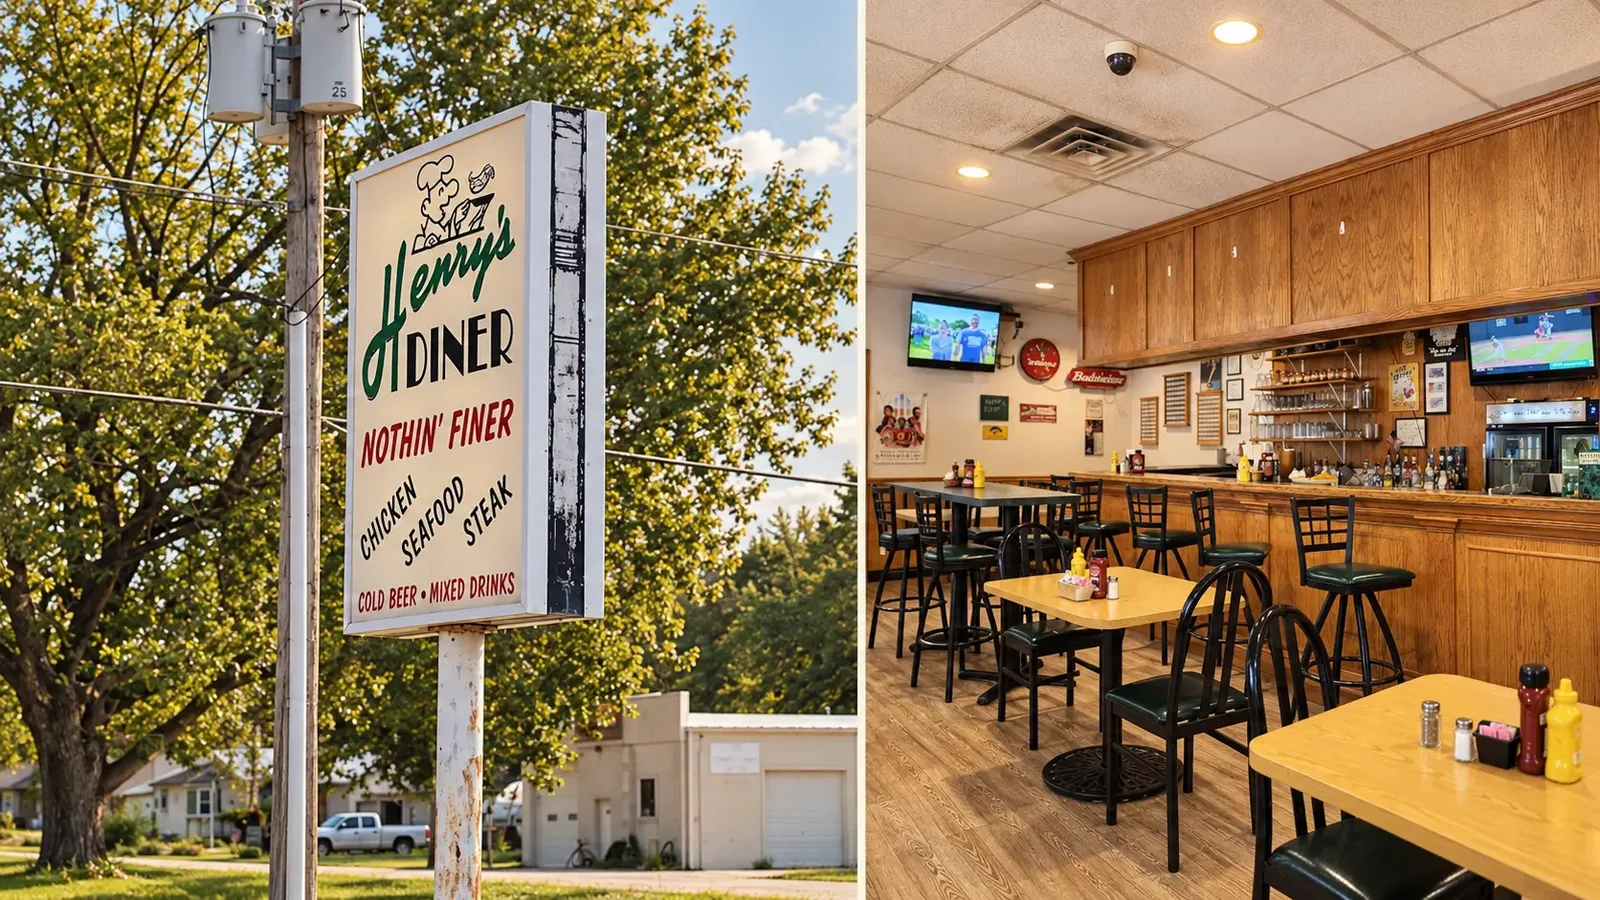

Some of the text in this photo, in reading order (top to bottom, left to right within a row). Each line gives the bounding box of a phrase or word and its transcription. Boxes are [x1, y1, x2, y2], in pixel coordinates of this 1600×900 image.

[332, 86, 347, 98] 25
[362, 205, 516, 400] Henry's
[406, 308, 514, 389] DINER
[361, 398, 515, 469] NOTHIN' FINER
[360, 474, 417, 561] CHICKEN
[401, 475, 464, 567] SEAFOOD
[463, 474, 514, 547] STEAK
[358, 571, 515, 613] COLD BEER MIXED DRINKS
